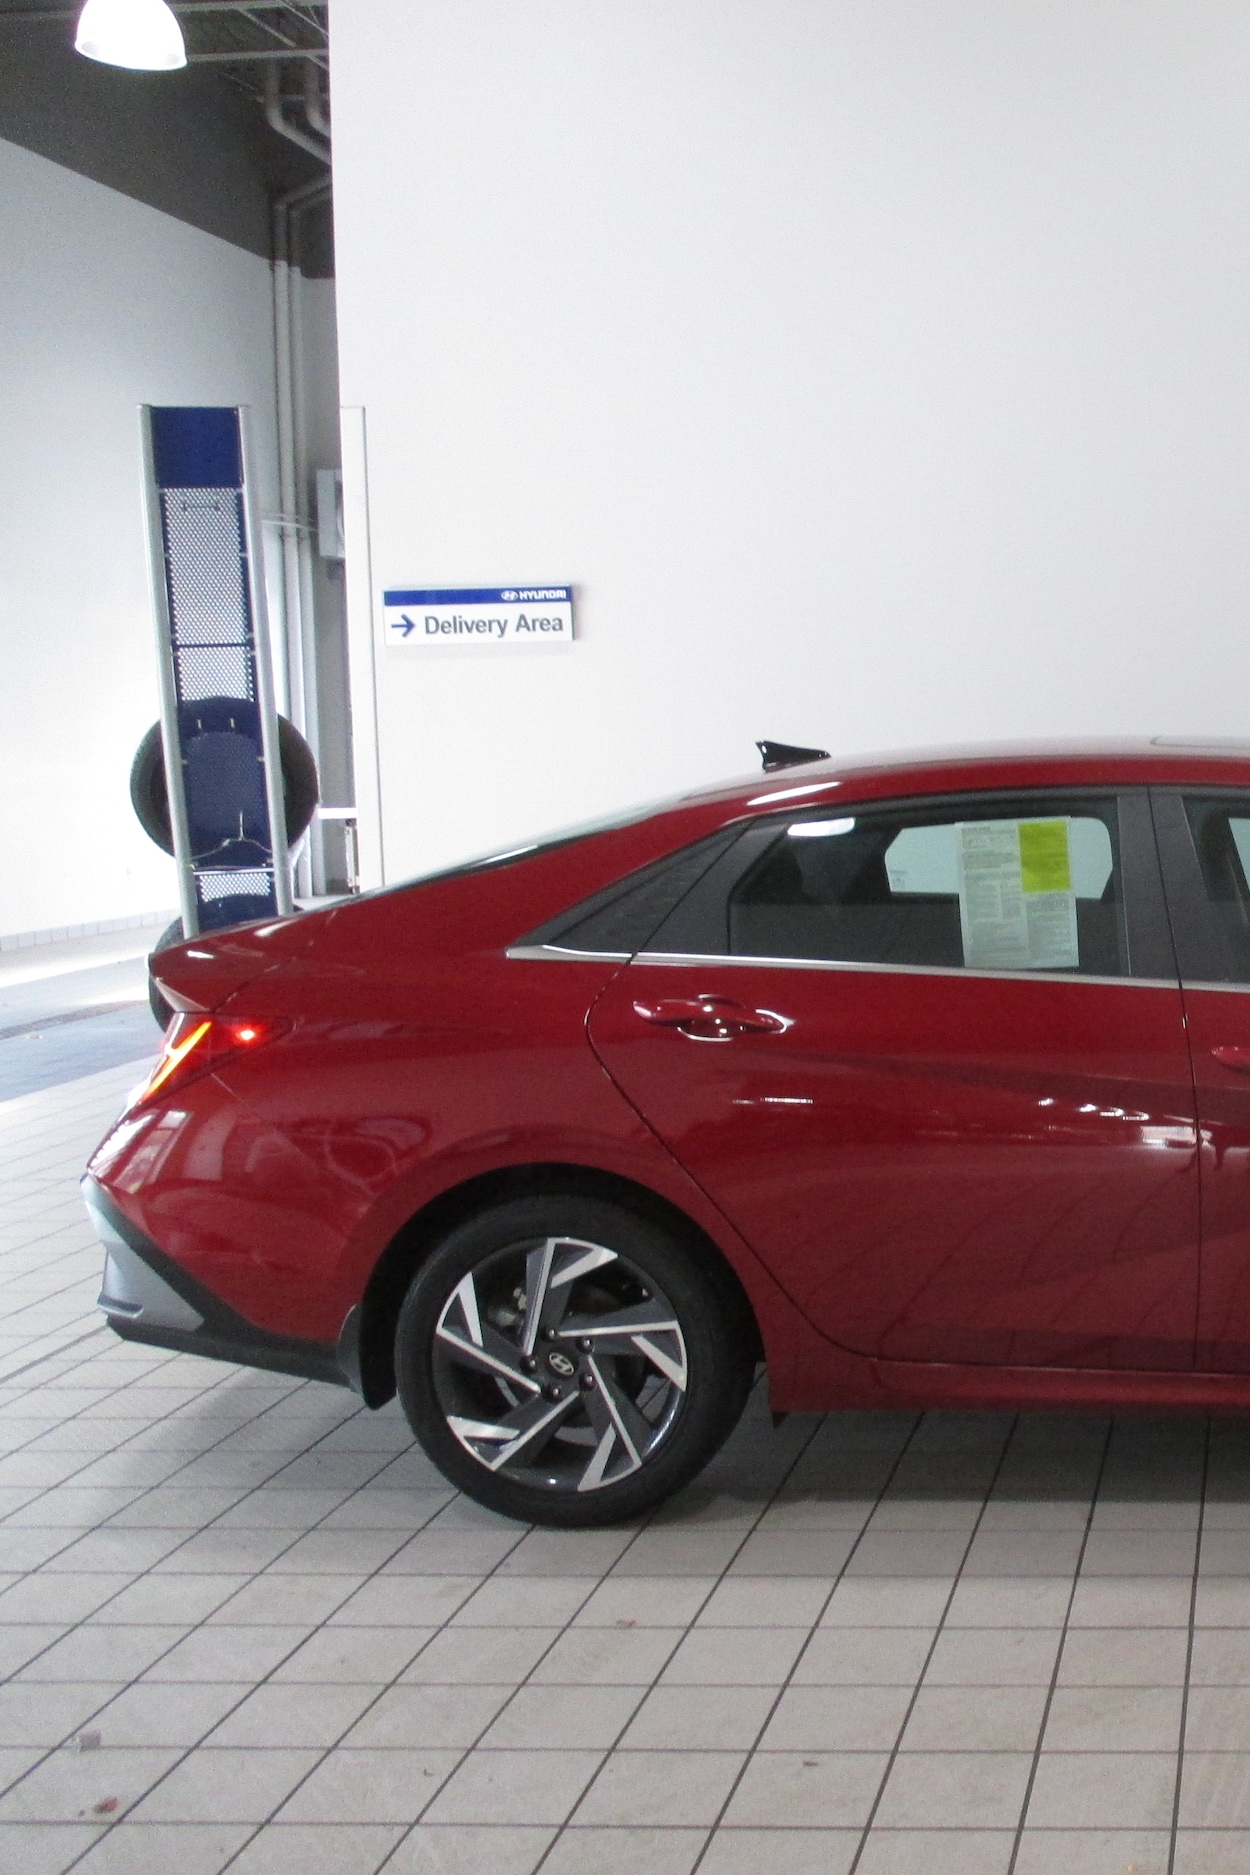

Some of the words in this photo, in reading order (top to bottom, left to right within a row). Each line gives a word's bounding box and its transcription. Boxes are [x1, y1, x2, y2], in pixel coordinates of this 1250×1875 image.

[519, 589, 567, 600] HYUNDAI
[424, 615, 509, 638] Delivery
[515, 613, 564, 633] Area
